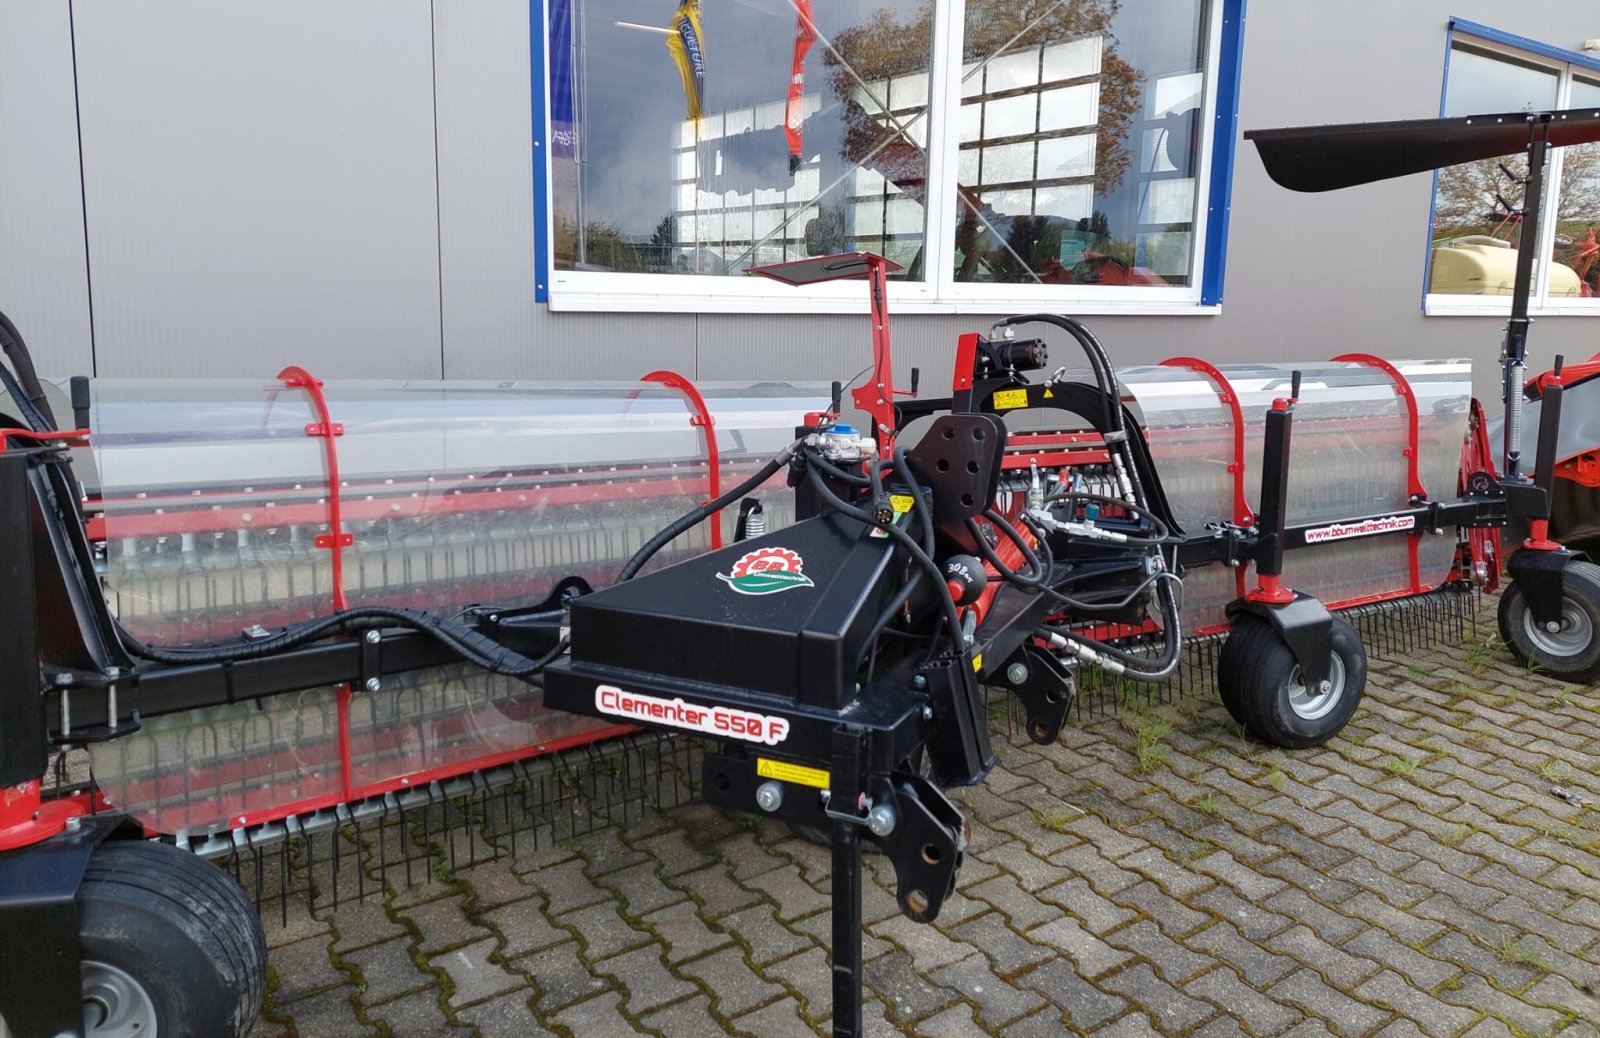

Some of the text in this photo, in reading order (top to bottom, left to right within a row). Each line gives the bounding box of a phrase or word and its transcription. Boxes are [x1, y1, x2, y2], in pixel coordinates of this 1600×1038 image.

[1307, 518, 1414, 540] www.bbumwelttechnik.com
[751, 560, 785, 572] BB
[601, 691, 784, 739] Clementer 550 F
